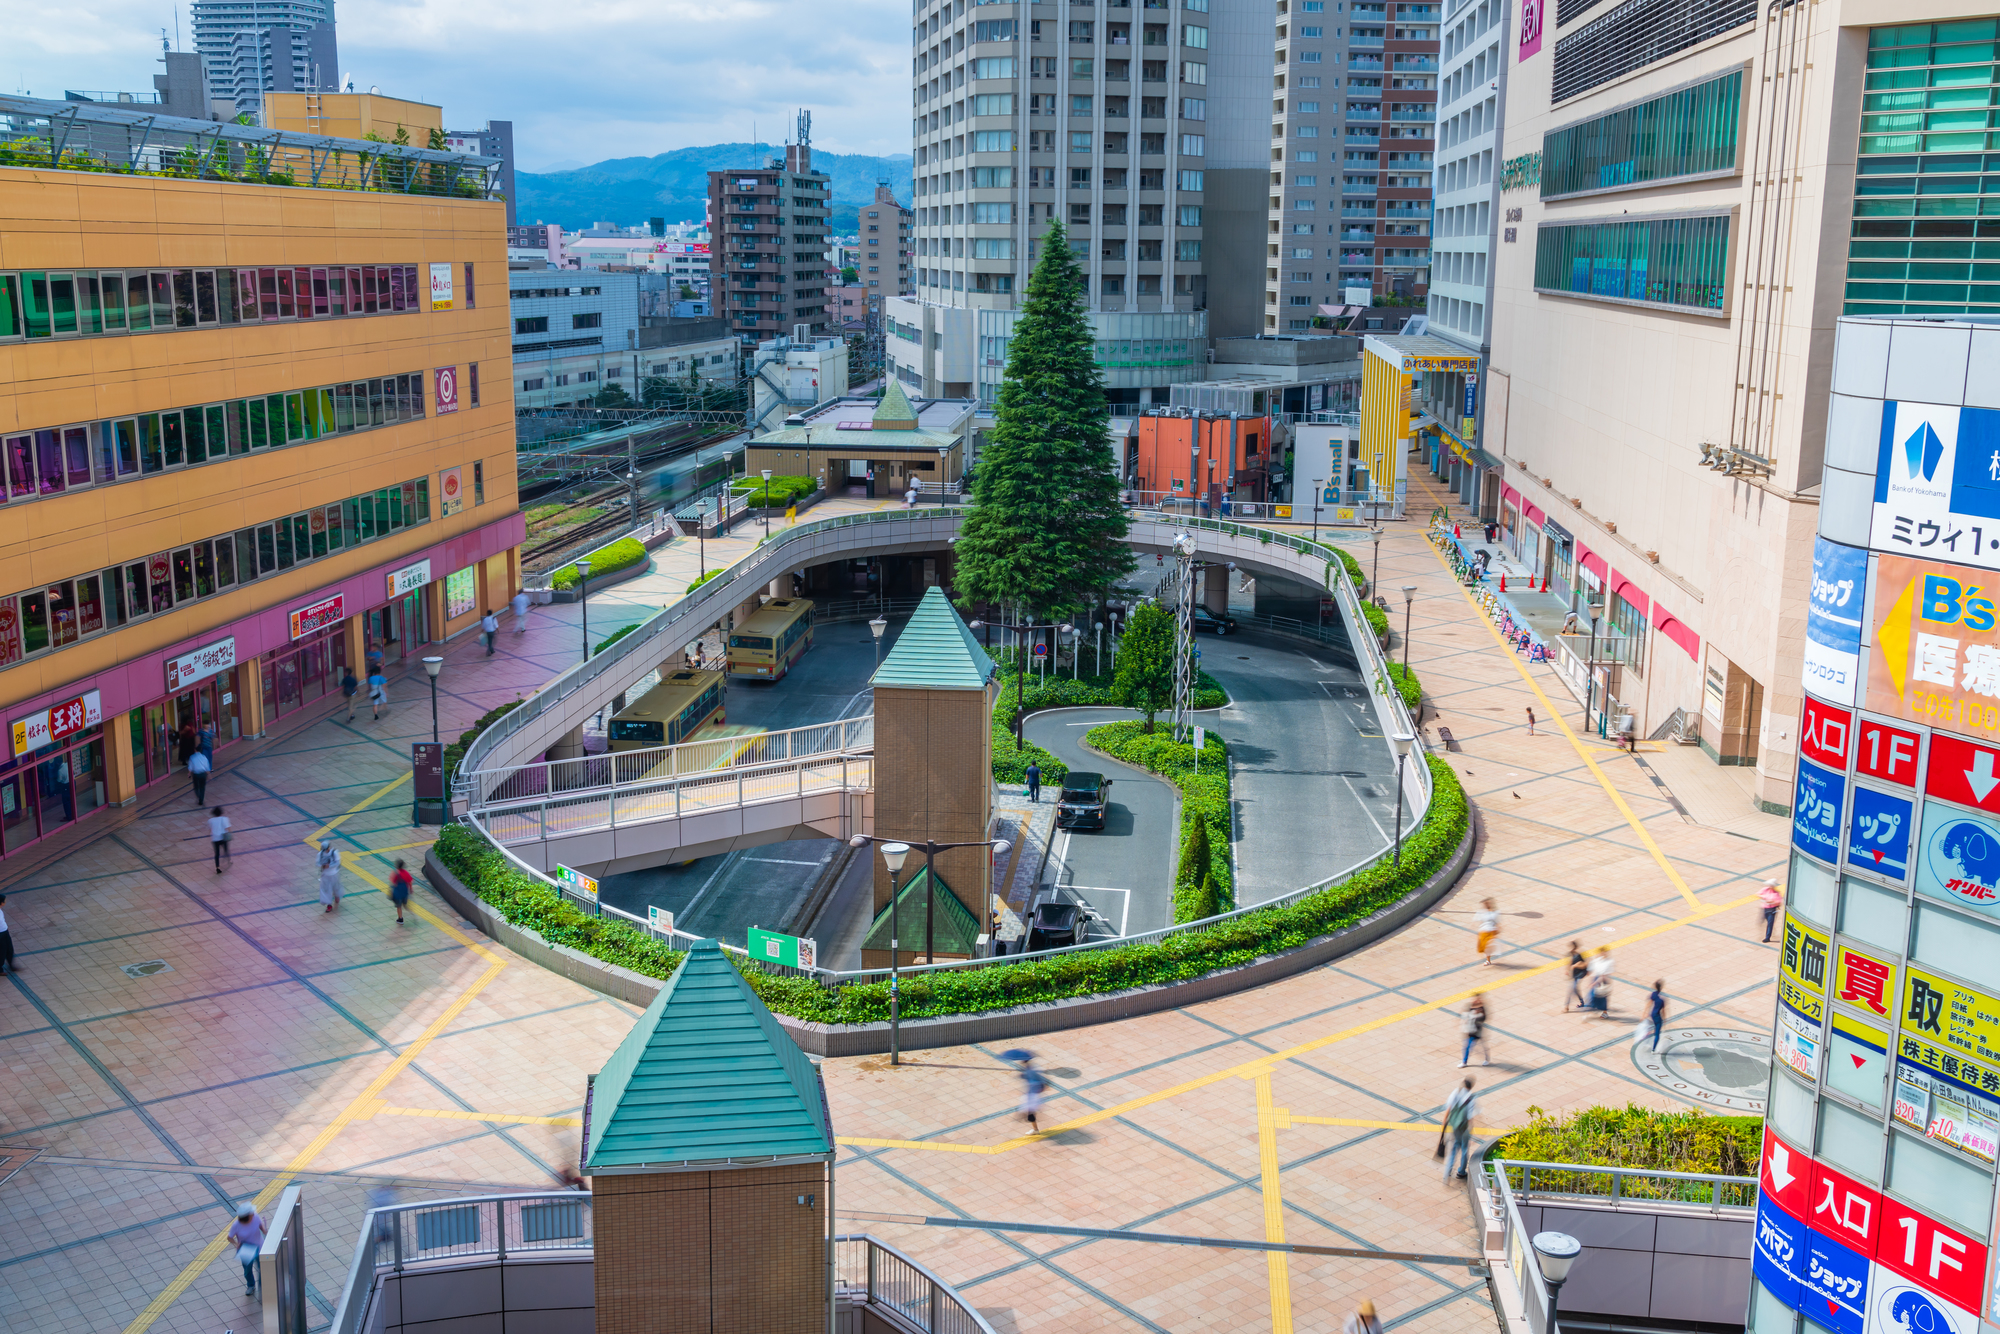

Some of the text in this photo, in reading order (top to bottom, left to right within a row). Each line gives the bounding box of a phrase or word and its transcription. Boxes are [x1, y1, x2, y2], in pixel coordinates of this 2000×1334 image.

[1403, 359, 1478, 369] ふれあい専門店街
[1892, 484, 1947, 498] Bank of Yokohama
[1912, 632, 2000, 700] 医療
[15, 731, 26, 745] 2F
[1803, 709, 1847, 757] 入口
[1866, 729, 1914, 775] 1F
[1945, 878, 1996, 899] オリバー
[1951, 1000, 1968, 1014] 印紙
[1976, 1010, 2000, 1026] はがき
[1950, 1011, 1975, 1028] 旅行券
[1950, 1023, 1987, 1044] レジャー券
[1948, 1033, 2000, 1062] 新幹線 回数券
[1791, 1049, 1807, 1072] 360
[1902, 1038, 2000, 1093] 株主優待券
[1895, 1099, 1914, 1121] 320
[1926, 1118, 1953, 1138] 510
[1962, 1132, 1996, 1156] 高価買取
[1815, 1177, 1871, 1239] 入口
[1898, 1216, 1966, 1280] 1F
